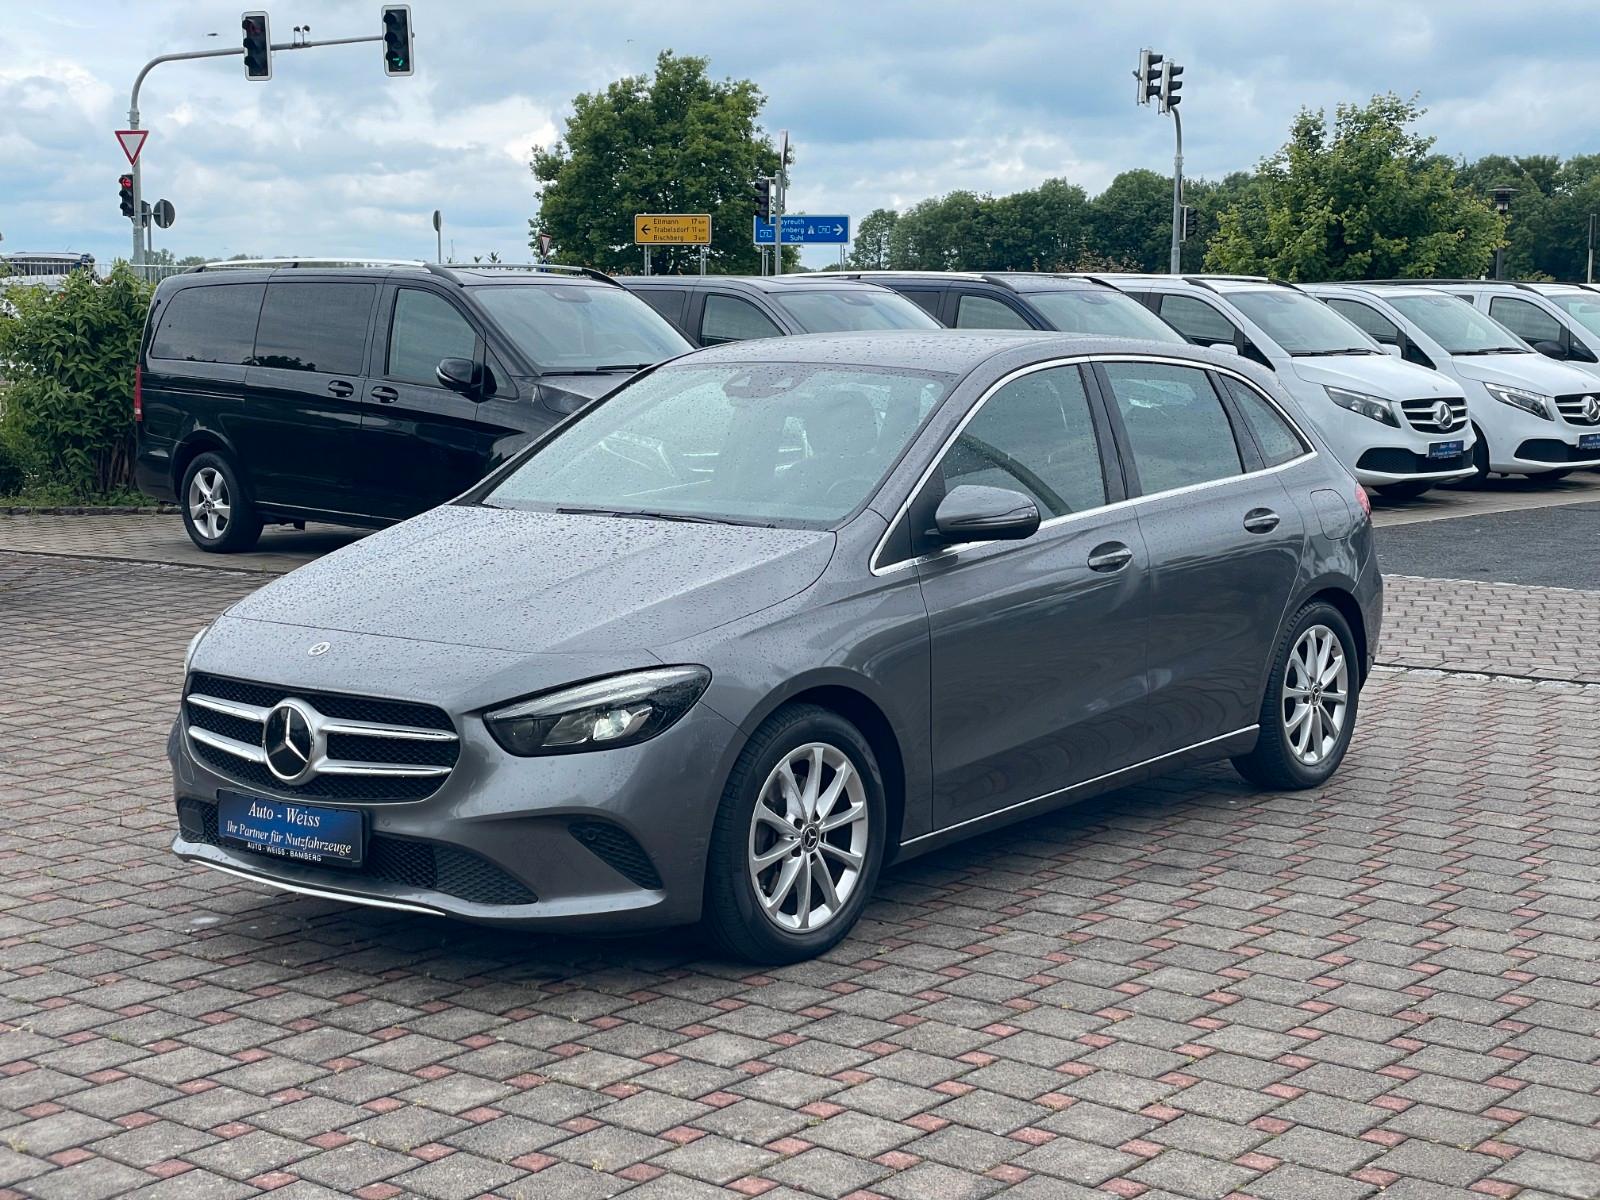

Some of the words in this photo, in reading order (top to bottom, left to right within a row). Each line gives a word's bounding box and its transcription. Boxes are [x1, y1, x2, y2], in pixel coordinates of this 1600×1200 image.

[248, 801, 274, 820] Auto
[286, 807, 321, 828] Weiss
[227, 820, 238, 834] Ihr
[239, 823, 269, 842] Partner
[268, 830, 284, 844] für
[285, 832, 352, 856] Nutzfahrzeuge
[247, 841, 262, 851] AUTO
[266, 846, 286, 856] WEISS
[289, 850, 322, 862] BAMBERG
